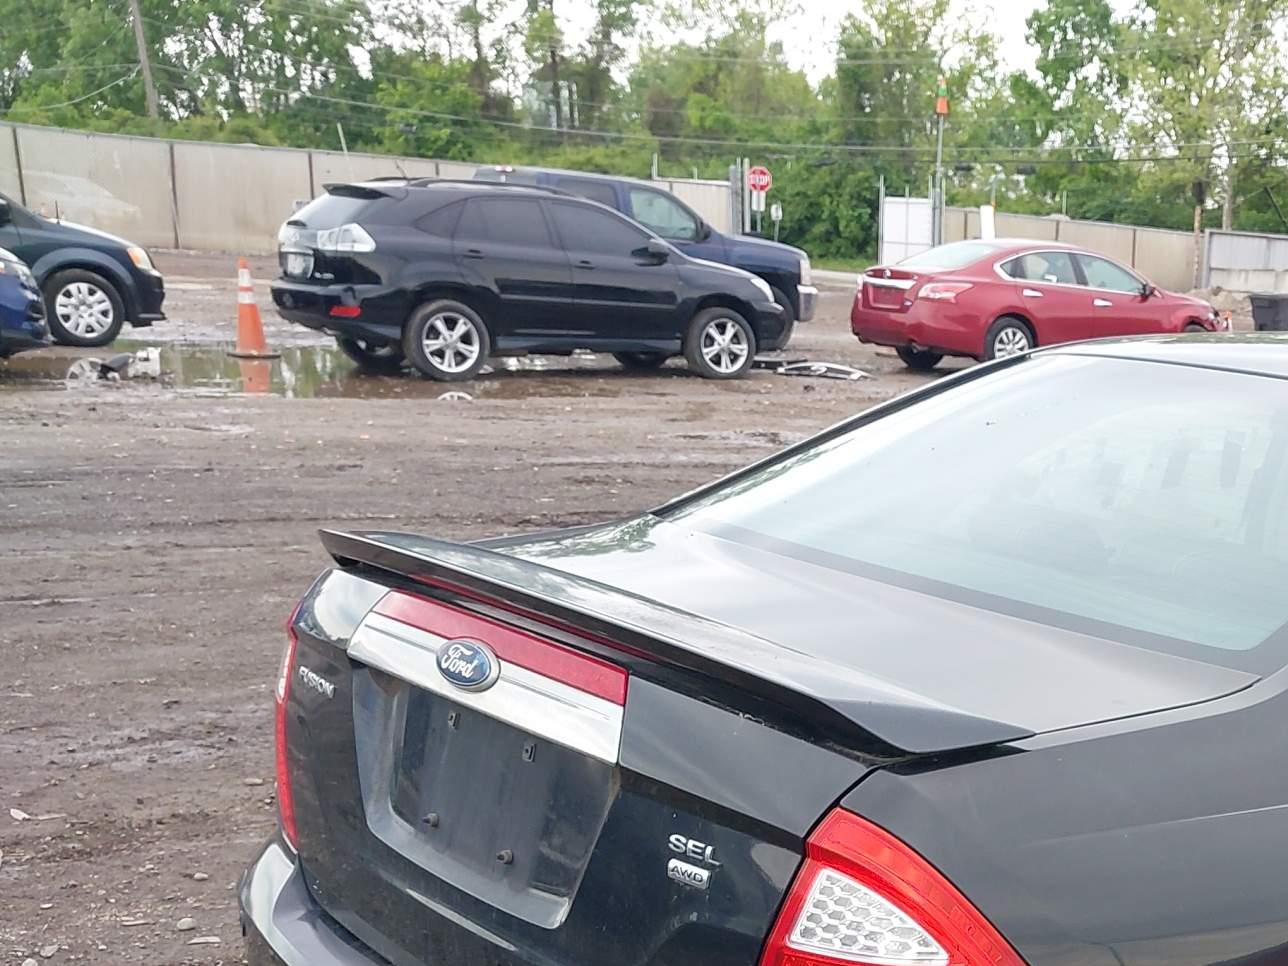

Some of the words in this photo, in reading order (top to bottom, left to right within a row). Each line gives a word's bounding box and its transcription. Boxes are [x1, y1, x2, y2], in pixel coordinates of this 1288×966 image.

[440, 644, 479, 678] Ford
[298, 665, 335, 699] FUSION
[667, 833, 721, 866] SEL
[670, 865, 704, 883] AWD
